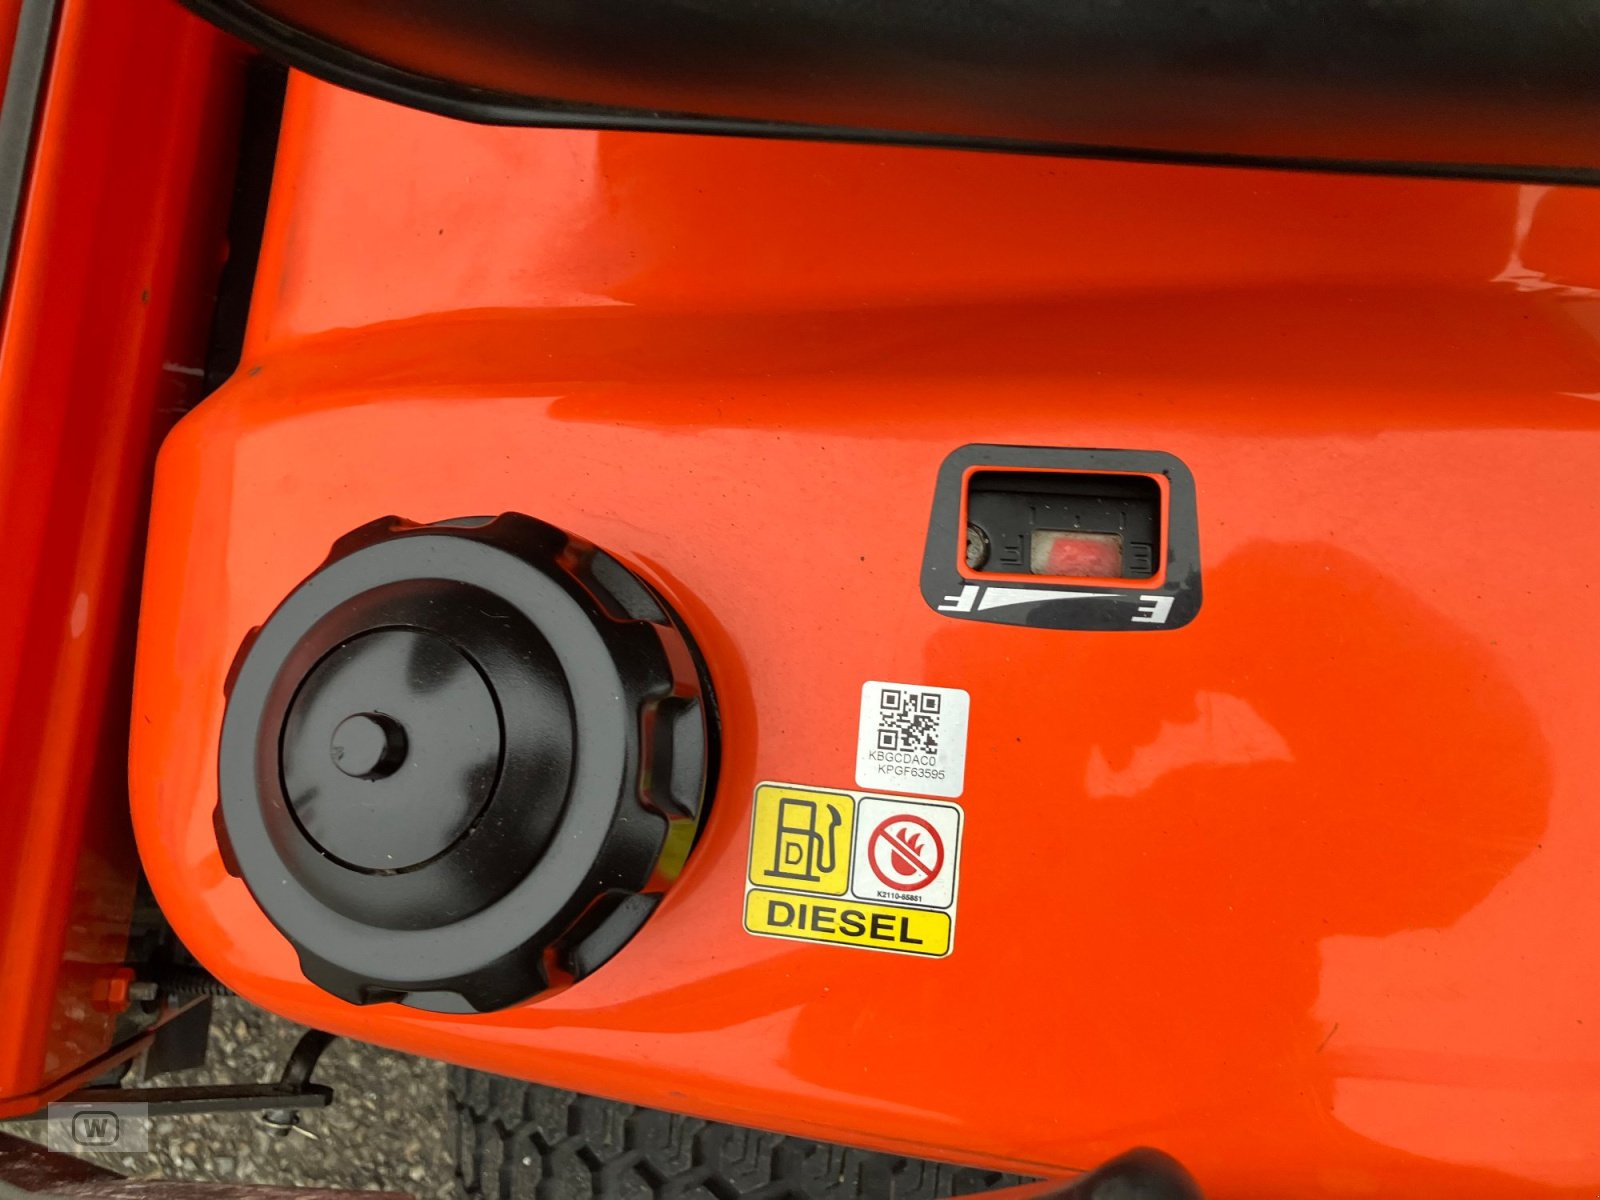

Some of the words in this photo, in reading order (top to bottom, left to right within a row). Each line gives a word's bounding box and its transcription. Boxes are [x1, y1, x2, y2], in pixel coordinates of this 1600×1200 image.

[937, 585, 980, 612] F
[1131, 594, 1175, 624] E
[878, 764, 945, 780] KPGF63595
[784, 842, 804, 865] D
[766, 900, 924, 945] DIESEL
